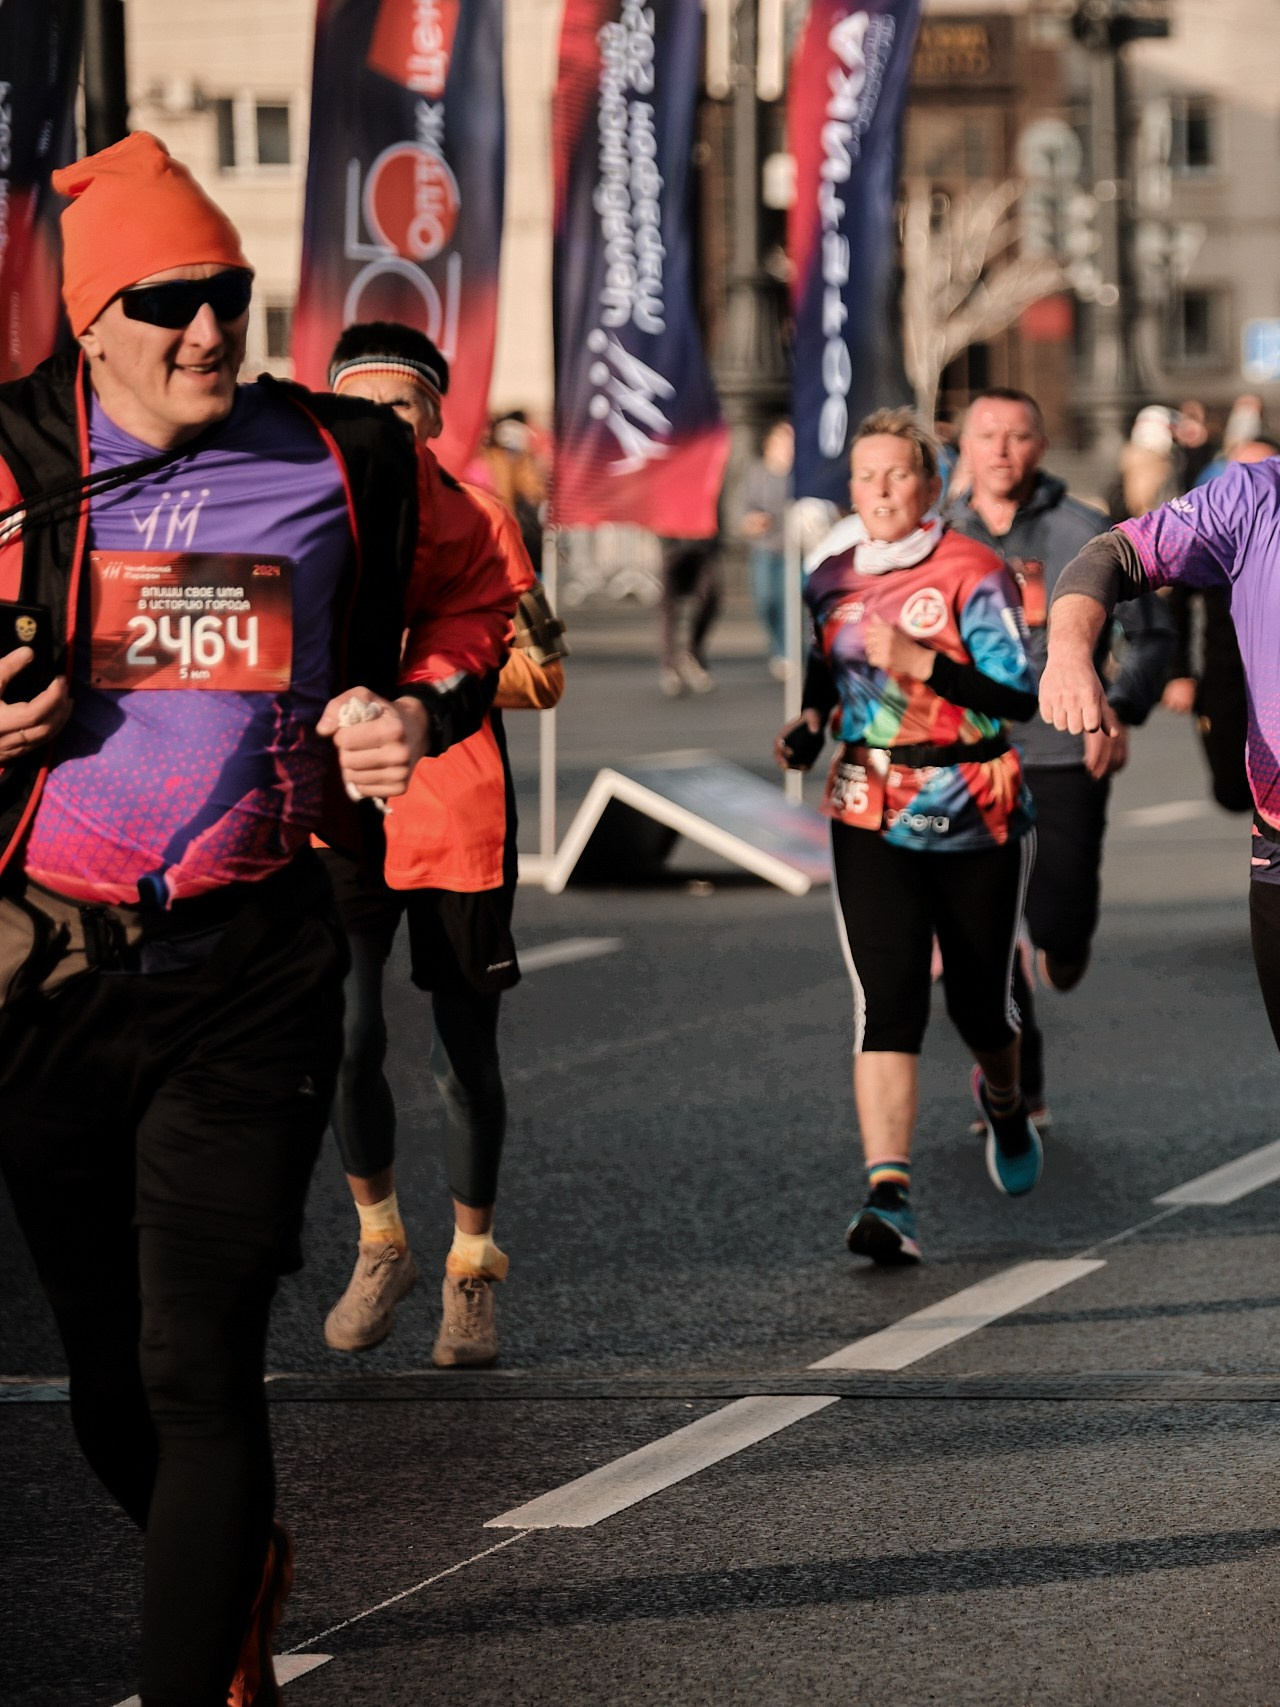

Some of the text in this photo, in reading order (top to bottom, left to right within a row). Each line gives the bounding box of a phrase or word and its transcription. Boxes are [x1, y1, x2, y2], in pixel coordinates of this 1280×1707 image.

[620, 0, 656, 95] 202
[252, 564, 281, 576] 2024
[184, 587, 215, 598] СВОЕ
[217, 587, 244, 598] ИМЯ
[138, 600, 251, 611] В ИСТОРИЮ ГОРОДА
[126, 615, 259, 667] 2464
[179, 668, 188, 680] 5
